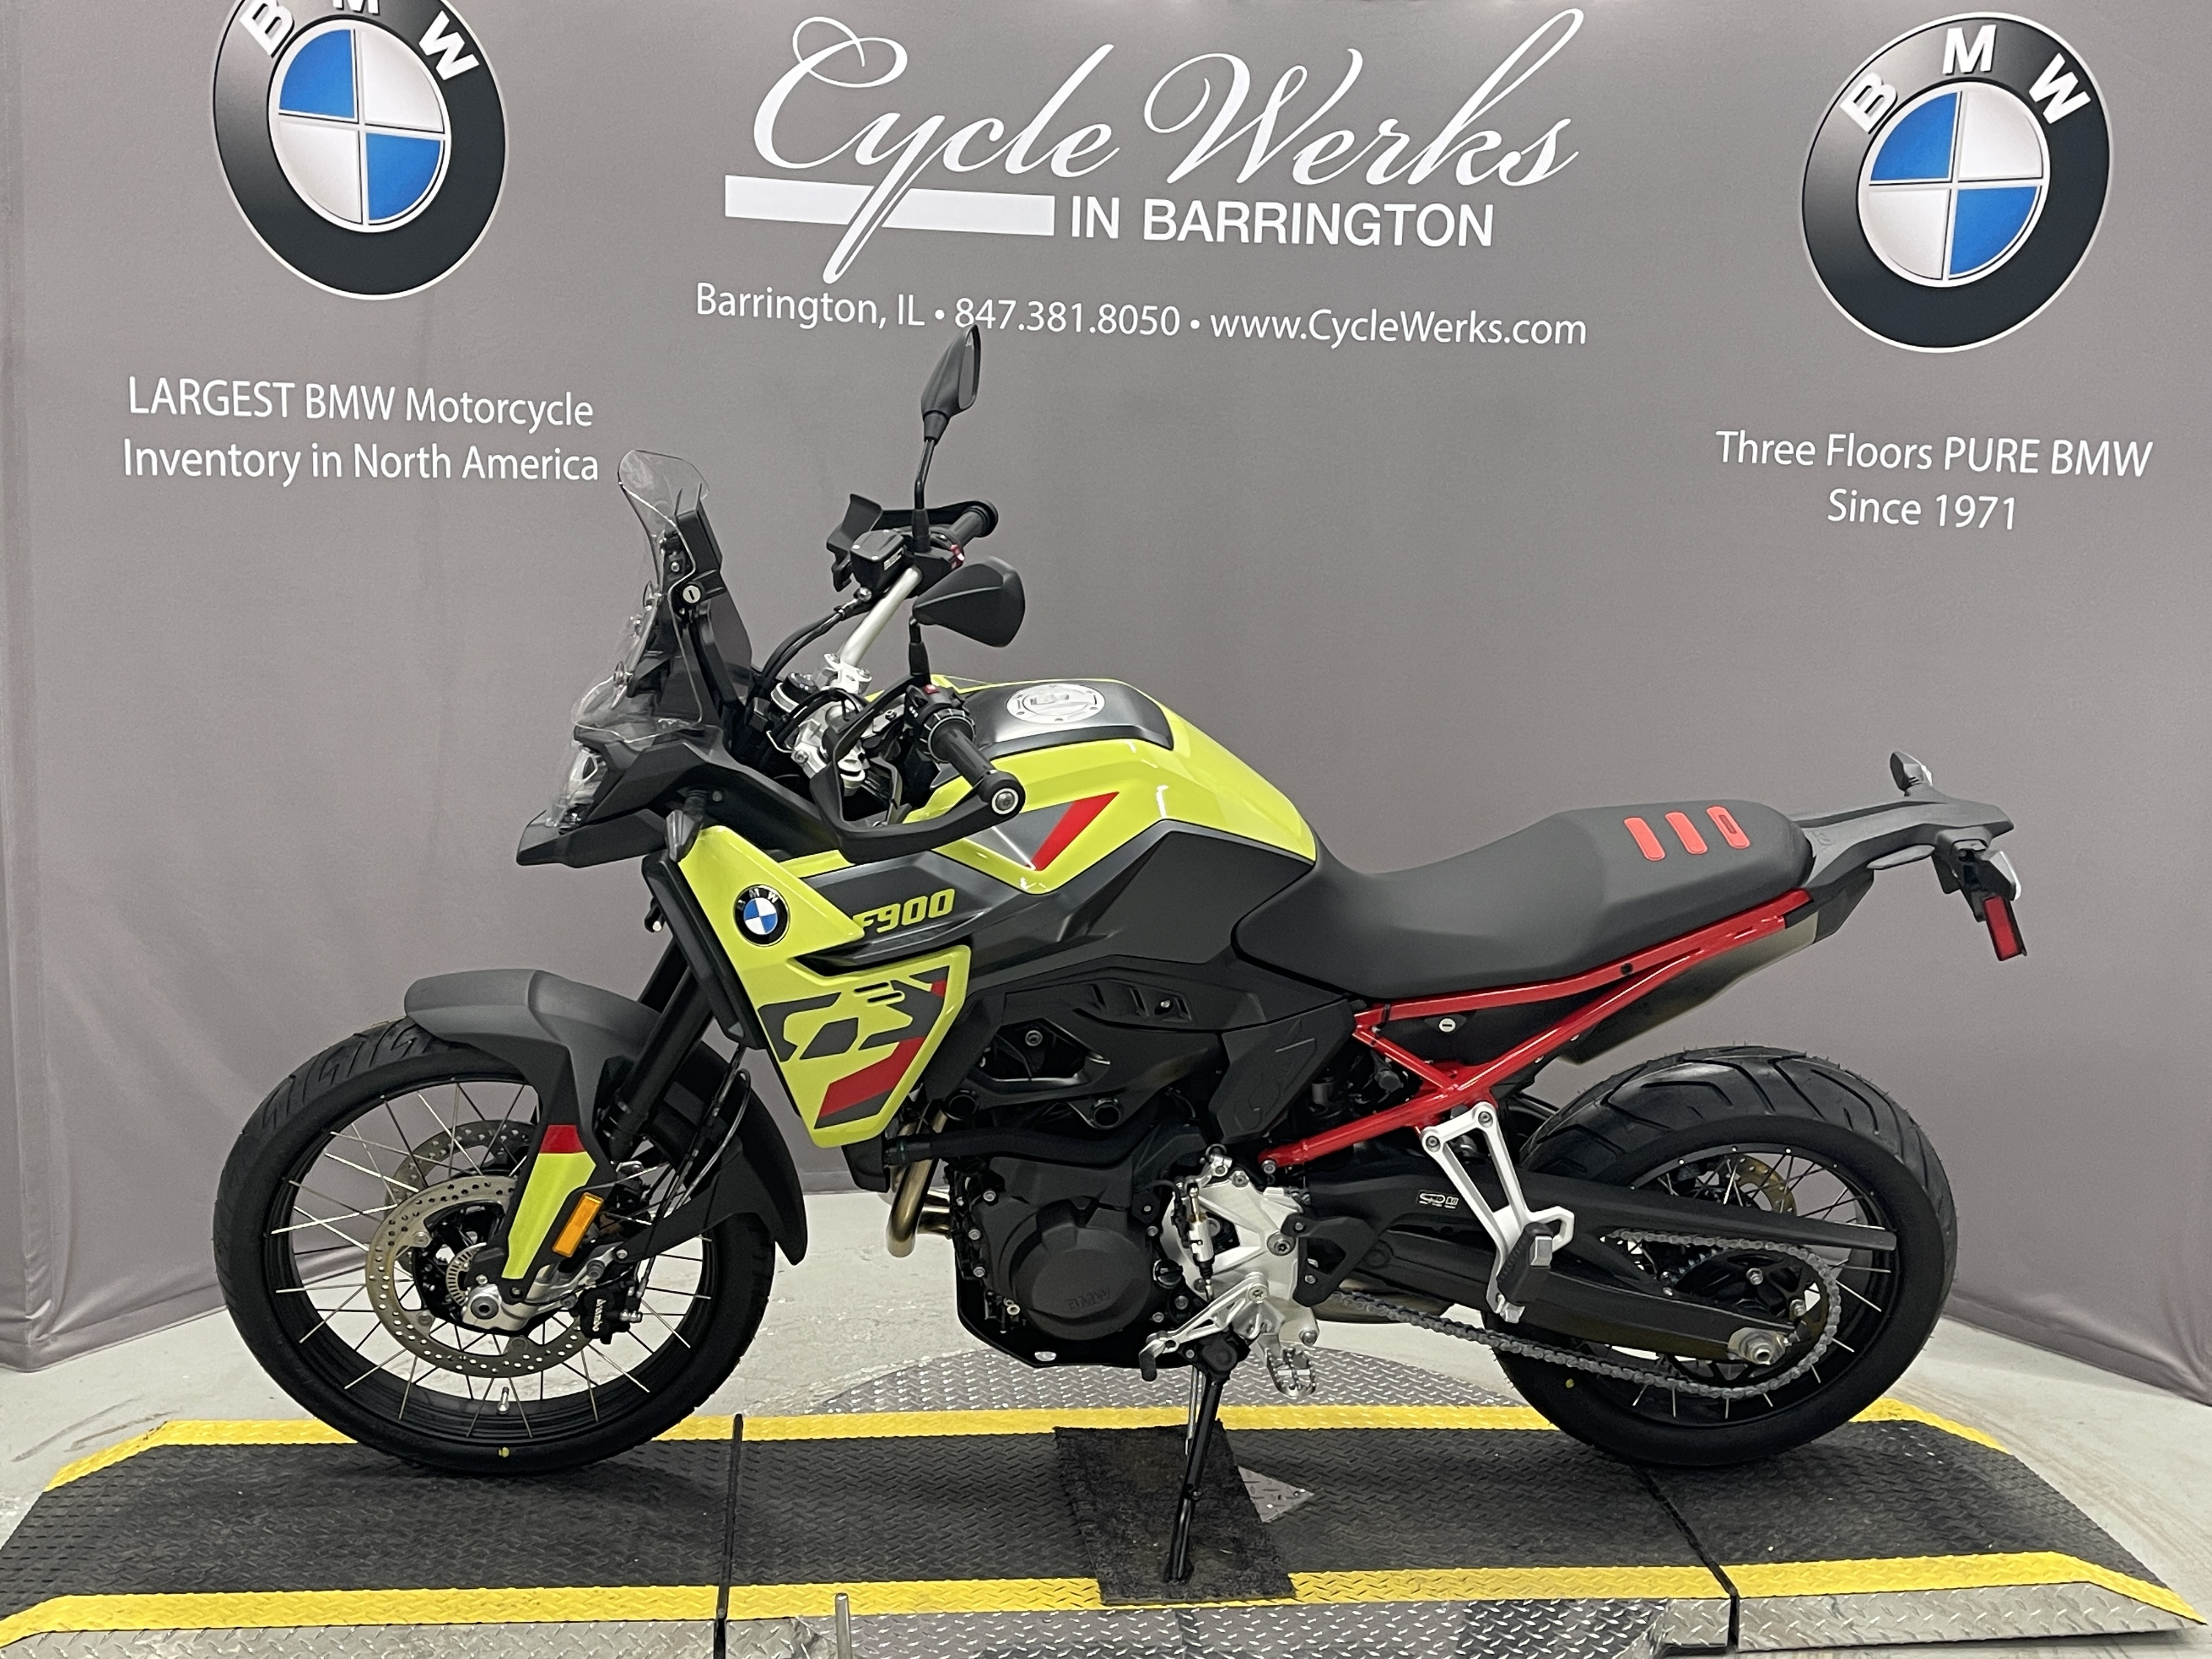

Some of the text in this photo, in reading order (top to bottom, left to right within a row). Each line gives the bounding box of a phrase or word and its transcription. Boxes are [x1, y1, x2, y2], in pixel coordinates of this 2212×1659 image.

[238, 0, 480, 81] BW
[1839, 24, 2091, 134] BMW
[753, 7, 1585, 285] Cycle Werks
[1071, 195, 1494, 247] IN BARRINGTON
[697, 281, 1587, 349] Barrington, IL 847.381.8050 www.CycleWerks.com
[129, 375, 594, 435] LARGEST BMW Motorcycle
[124, 438, 599, 488] Inventory in North America
[1715, 429, 2154, 478] Three Floors PURE BMW
[1827, 488, 2015, 531] Since 1971
[852, 888, 956, 934] F900
